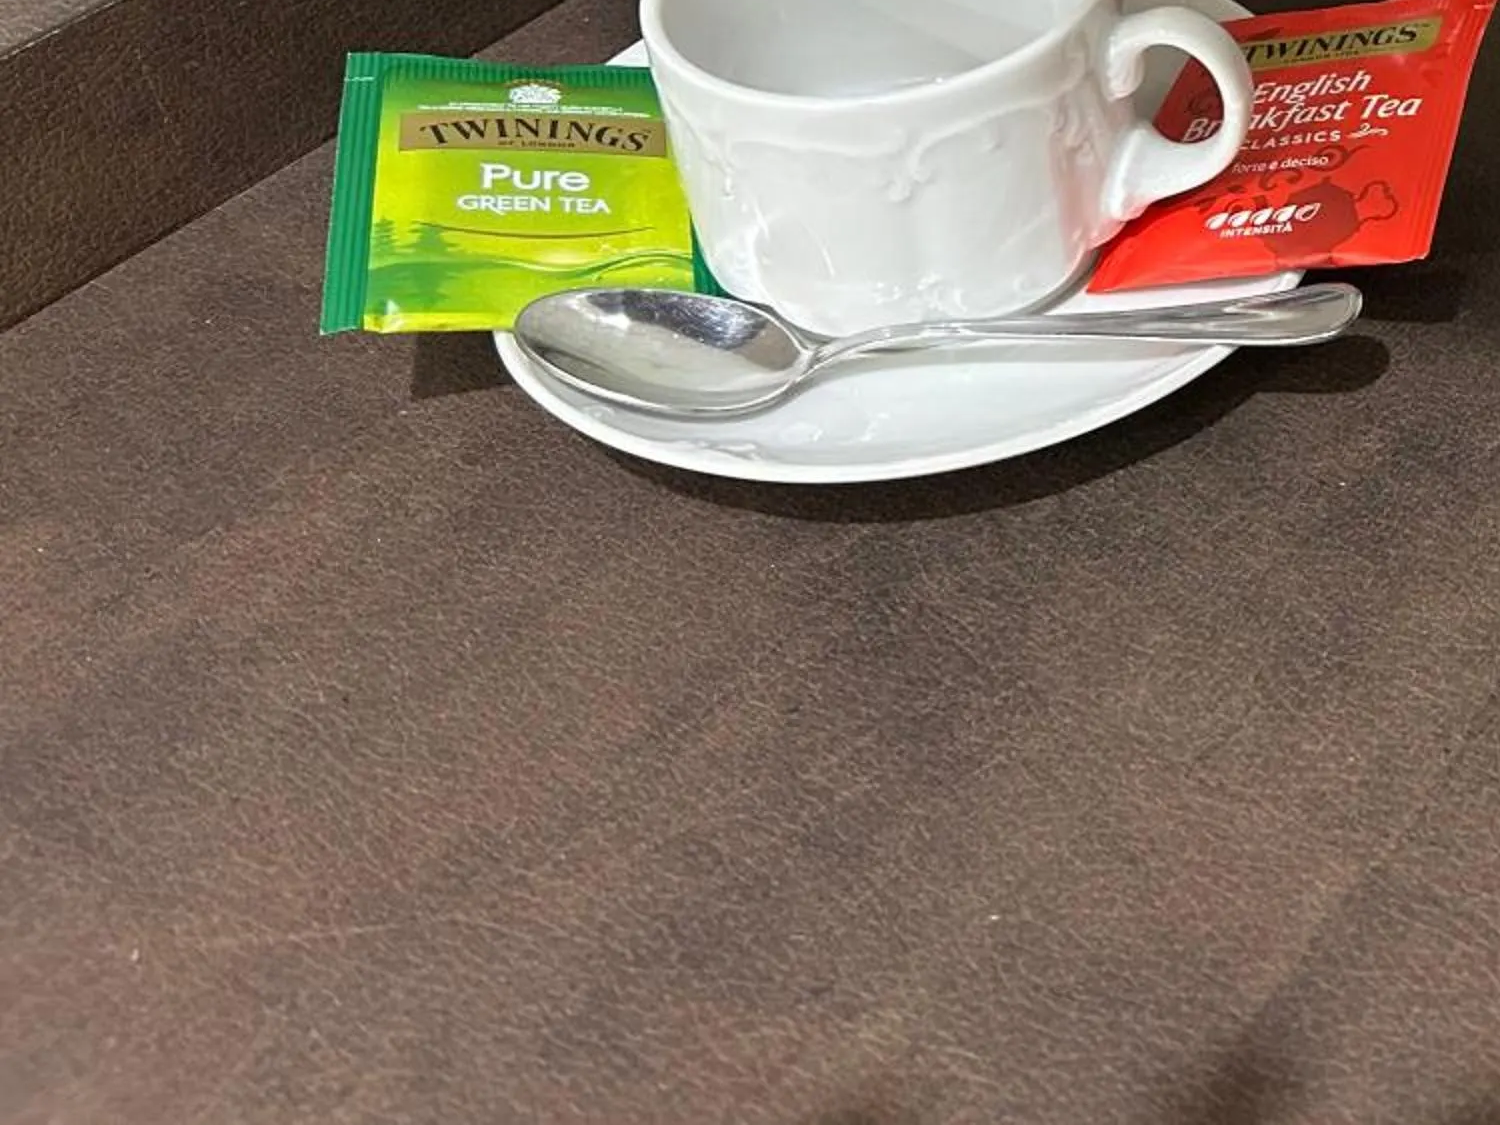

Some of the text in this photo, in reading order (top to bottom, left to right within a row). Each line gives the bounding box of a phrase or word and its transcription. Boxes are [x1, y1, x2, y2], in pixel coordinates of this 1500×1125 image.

[1243, 26, 1418, 62] TWININGS
[1253, 70, 1372, 104] English
[420, 117, 651, 152] TWININGS
[1182, 93, 1423, 142] Brkfast Tea
[480, 163, 590, 192] Pure
[1269, 159, 1279, 171] e
[1281, 155, 1329, 169] deciso
[457, 194, 611, 215] GREEN TEA
